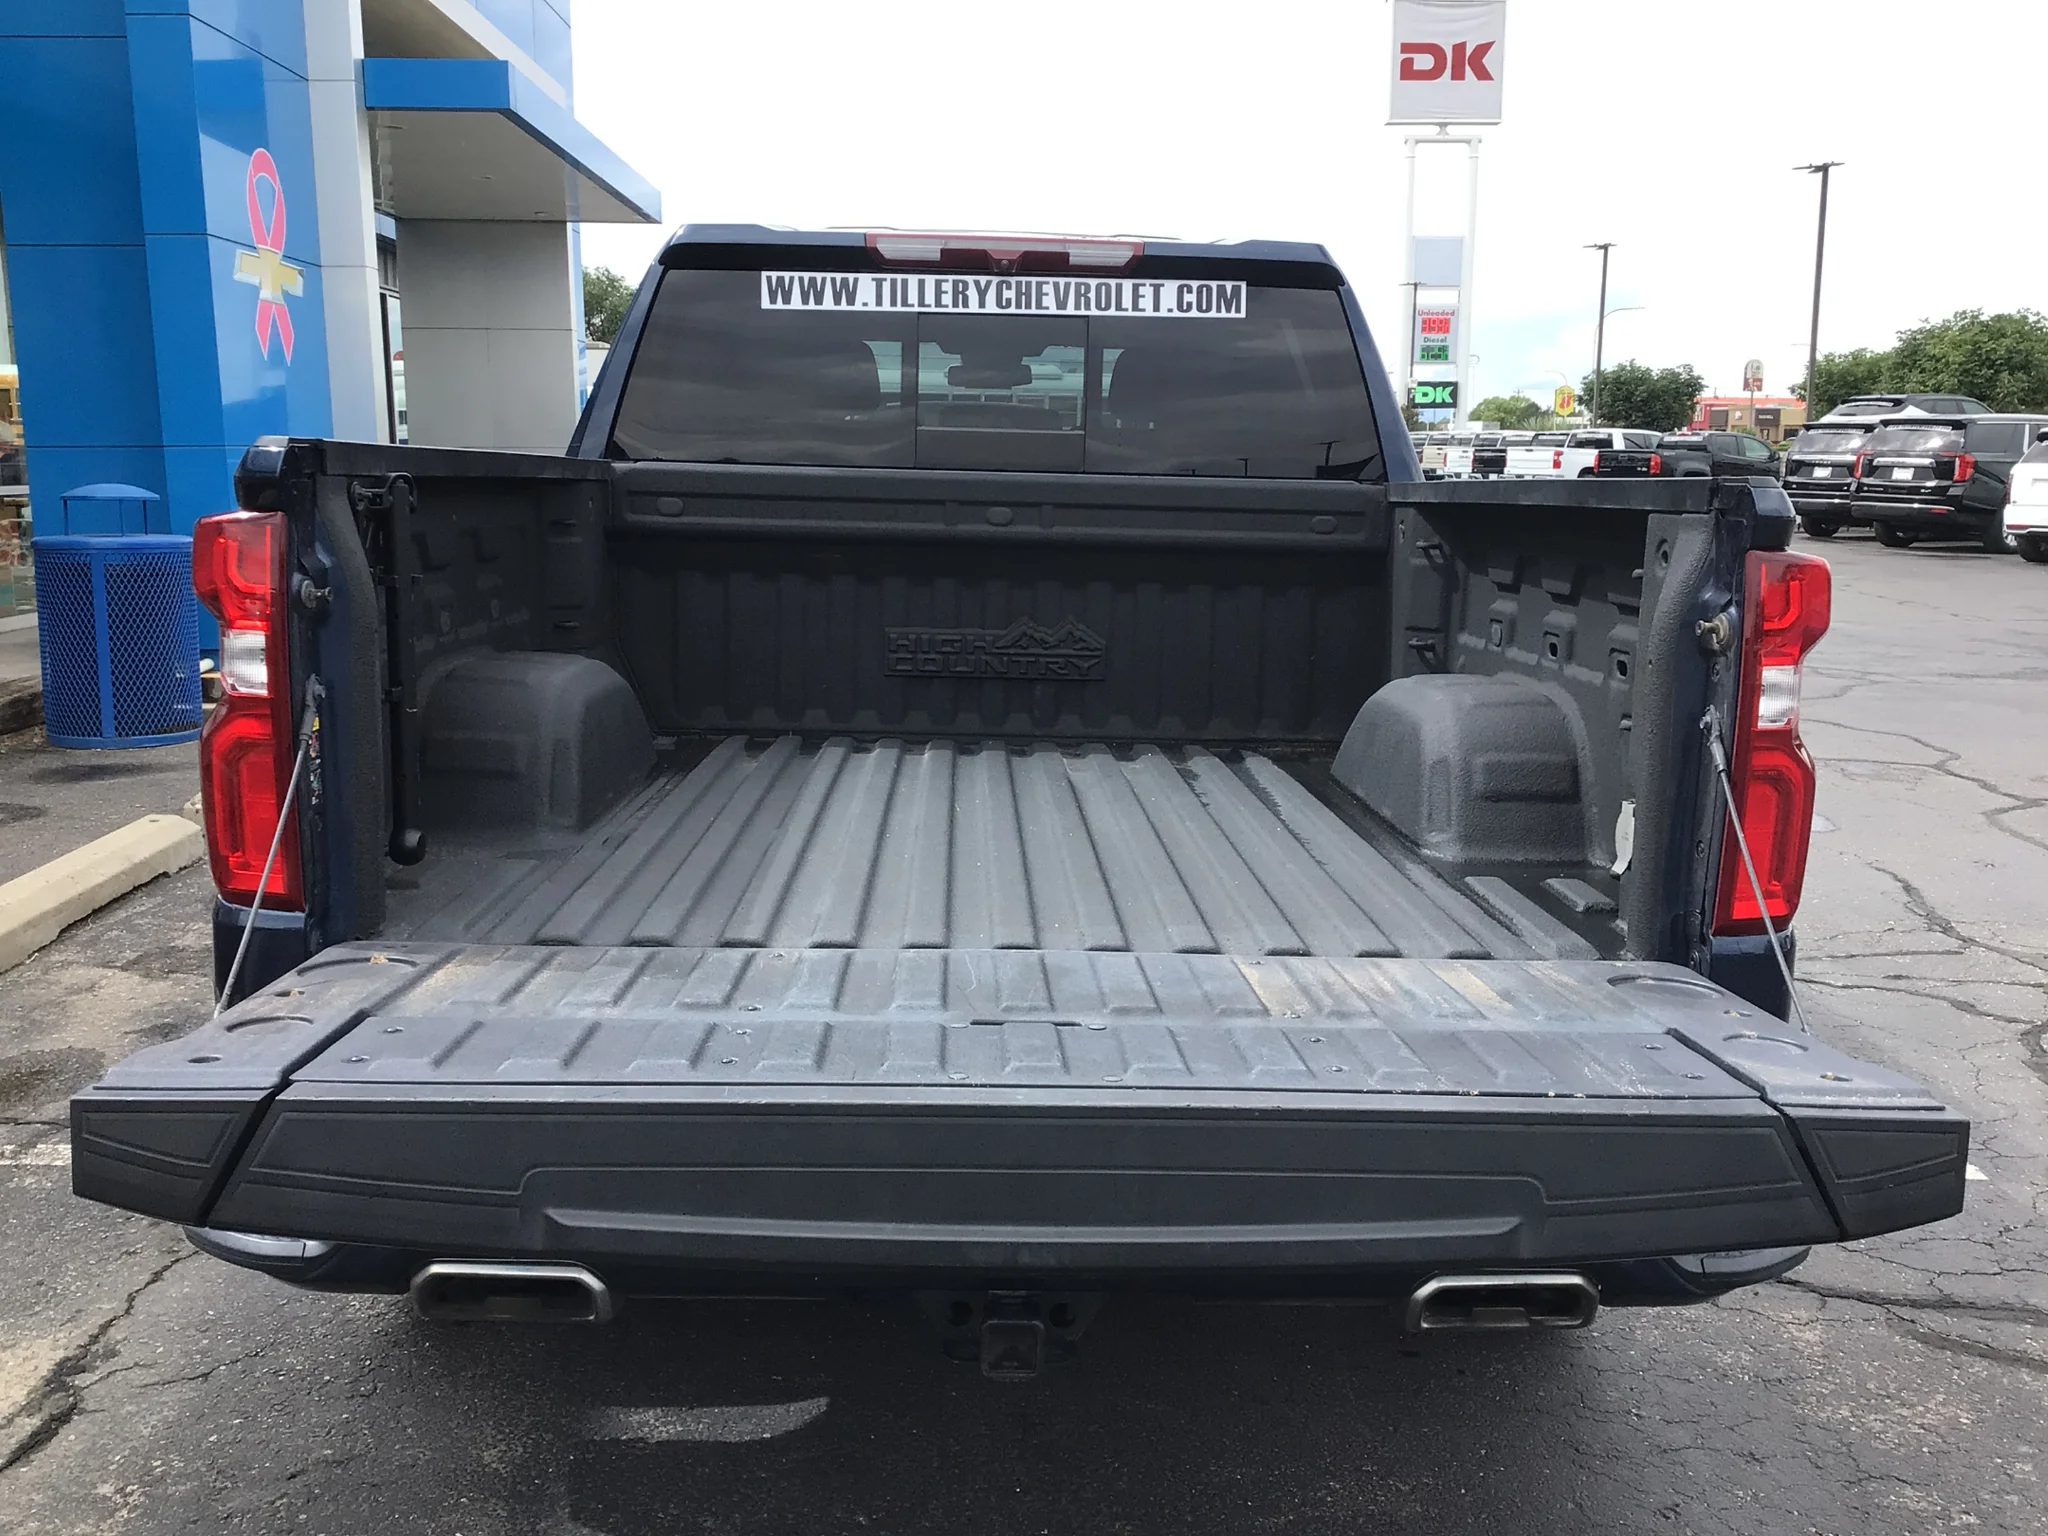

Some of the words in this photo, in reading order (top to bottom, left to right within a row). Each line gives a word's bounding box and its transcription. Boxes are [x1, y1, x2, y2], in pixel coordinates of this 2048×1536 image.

[1400, 40, 1496, 81] DK
[765, 274, 1242, 314] WWW.TILLERYCHEVROLET.COM
[1414, 386, 1454, 403] DK
[888, 632, 995, 654] HIGH
[888, 654, 1101, 676] COUNTRY
